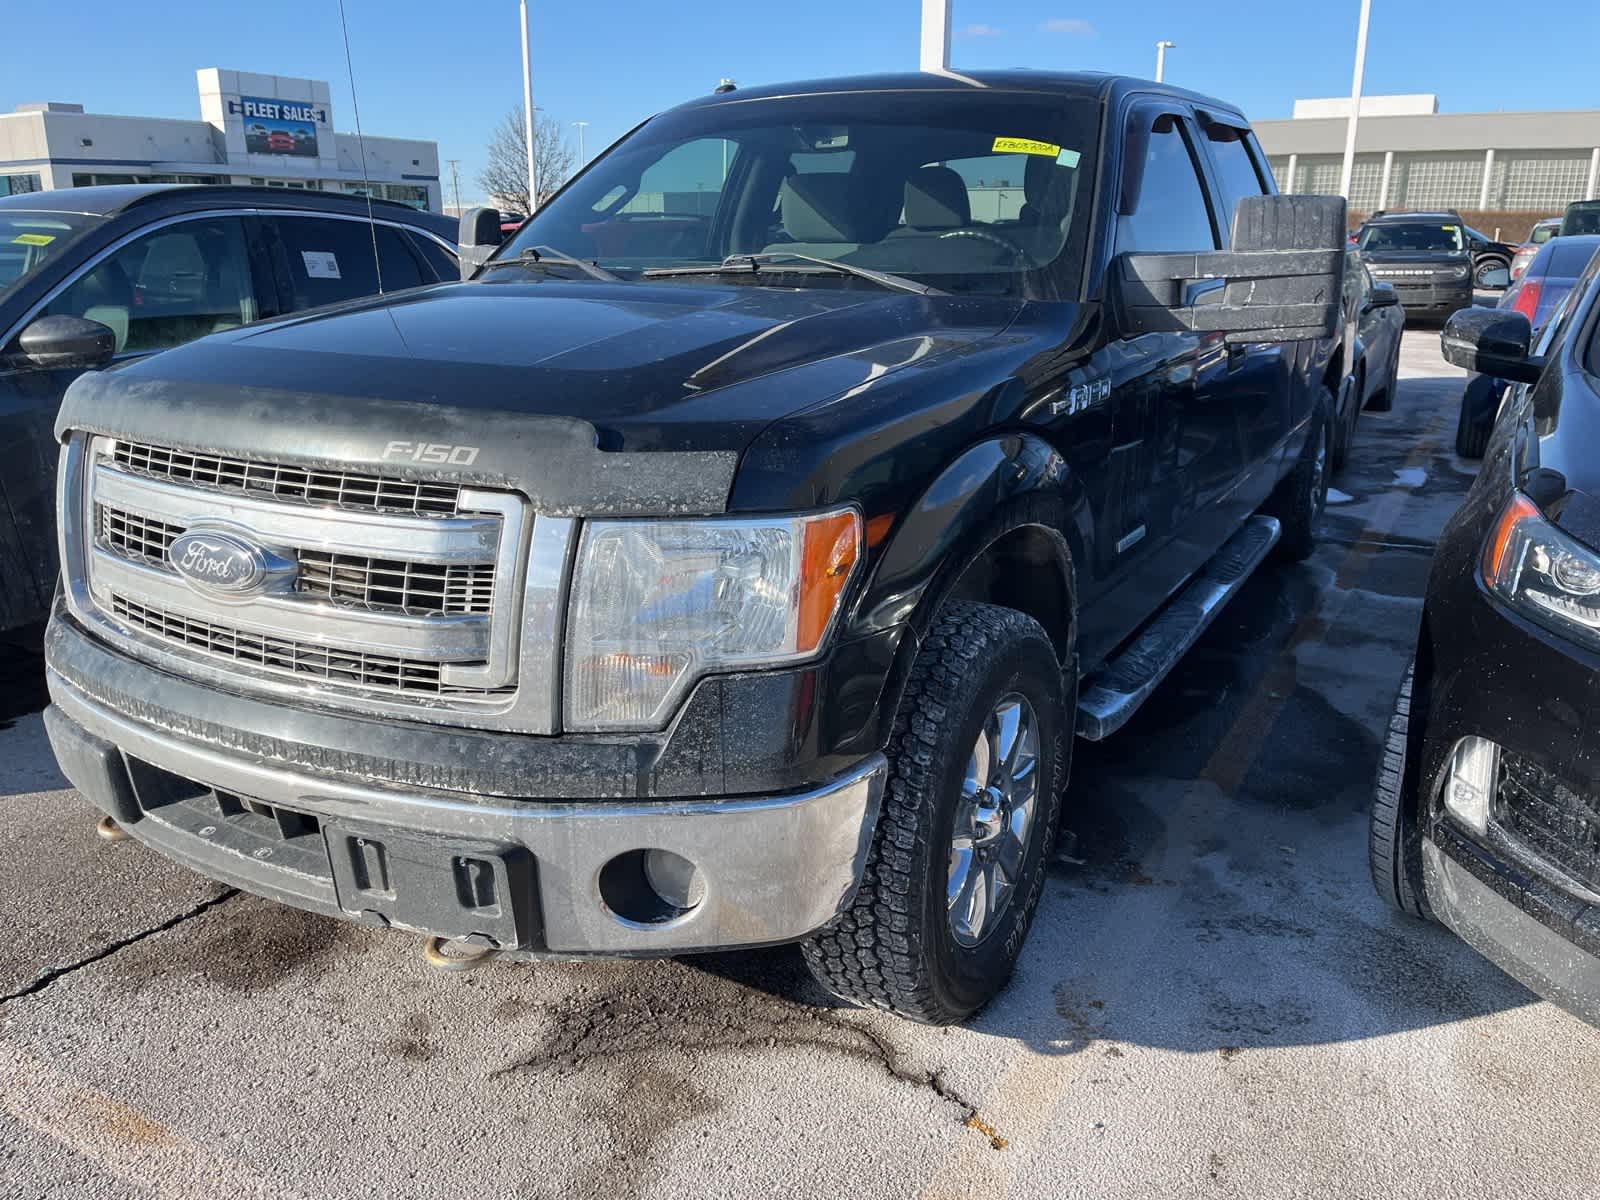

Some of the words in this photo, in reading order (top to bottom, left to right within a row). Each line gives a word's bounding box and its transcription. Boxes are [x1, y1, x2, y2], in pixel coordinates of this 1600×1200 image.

[243, 101, 280, 119] FLEET
[283, 105, 317, 122] SALES
[382, 441, 480, 465] F-150
[181, 541, 232, 577] Ford
